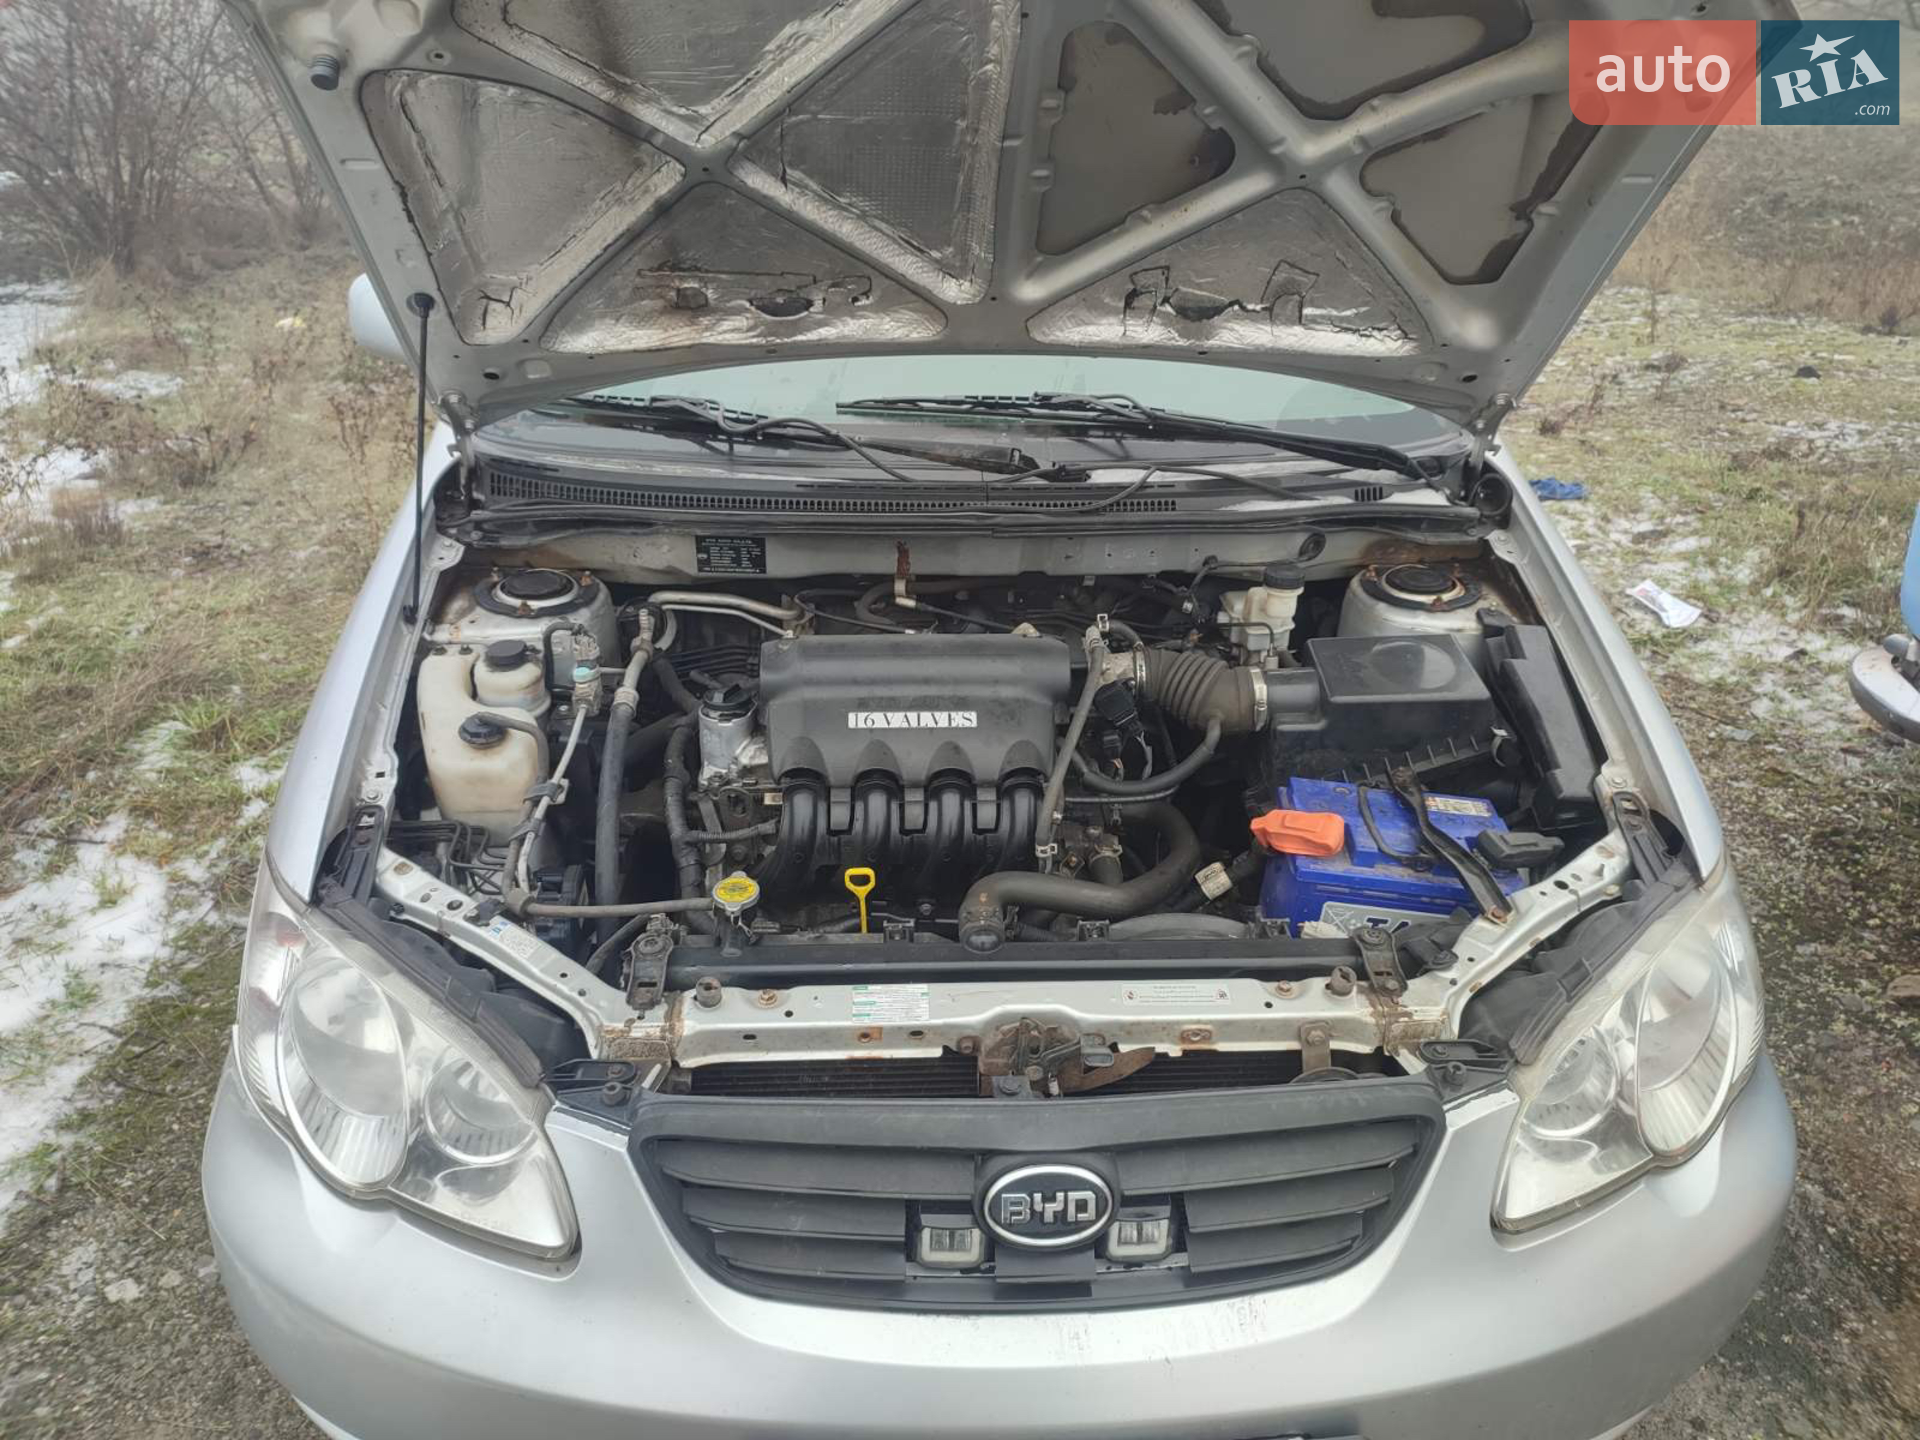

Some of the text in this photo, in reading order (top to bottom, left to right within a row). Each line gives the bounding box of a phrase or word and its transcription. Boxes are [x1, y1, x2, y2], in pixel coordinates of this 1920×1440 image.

[852, 712, 975, 728] 16 VALVES
[1001, 1190, 1097, 1225] BYD
